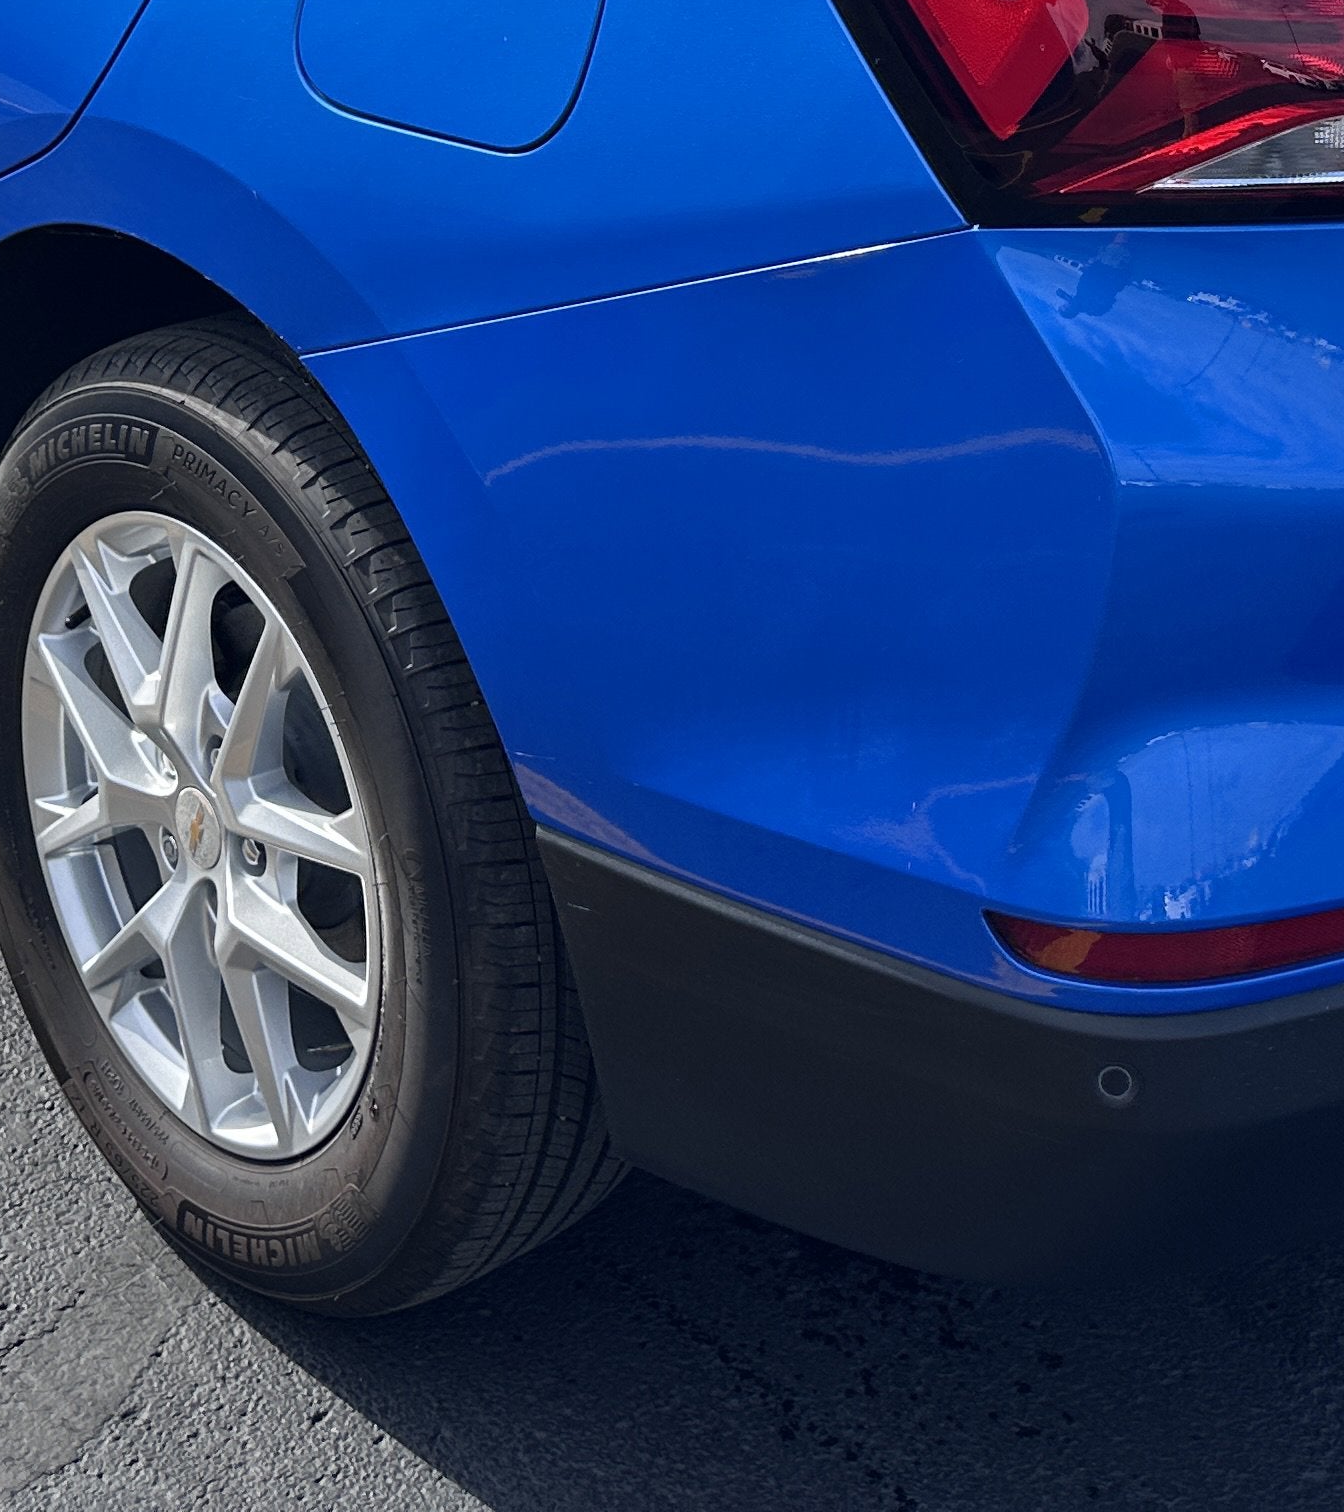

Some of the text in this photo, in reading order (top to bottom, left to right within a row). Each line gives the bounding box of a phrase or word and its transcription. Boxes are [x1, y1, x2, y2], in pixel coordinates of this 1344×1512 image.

[27, 423, 150, 481] MICHELIN
[171, 444, 257, 519] PRIMACY
[183, 1209, 322, 1268] MICHELIN
